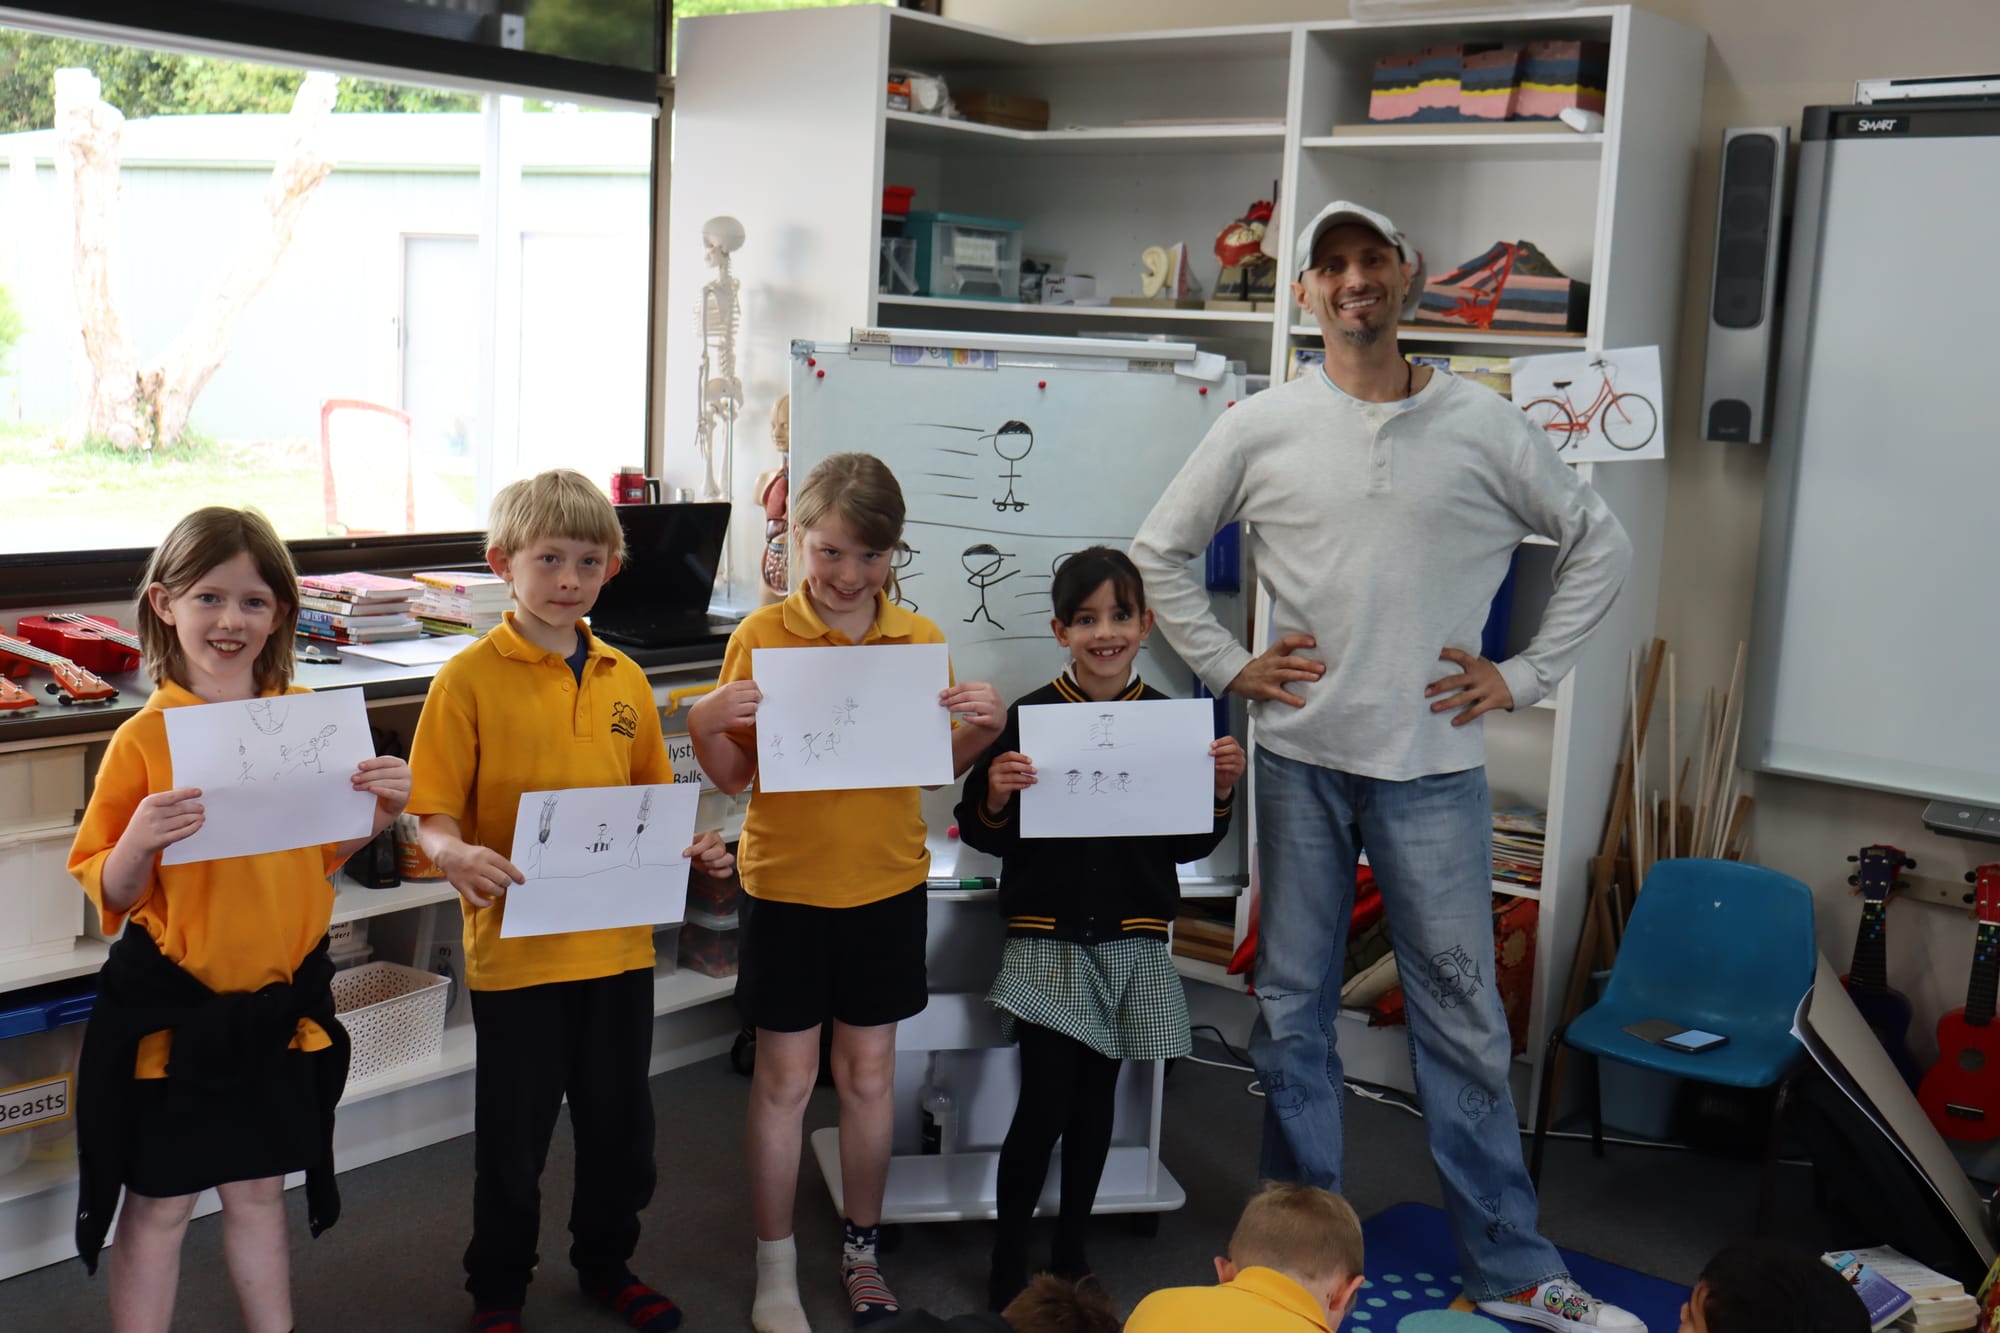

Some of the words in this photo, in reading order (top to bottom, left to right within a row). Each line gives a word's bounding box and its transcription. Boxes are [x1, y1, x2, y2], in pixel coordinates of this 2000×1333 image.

[1858, 119, 1897, 131] SMART
[673, 769, 703, 784] Balls
[0, 1094, 64, 1122] Beasts
